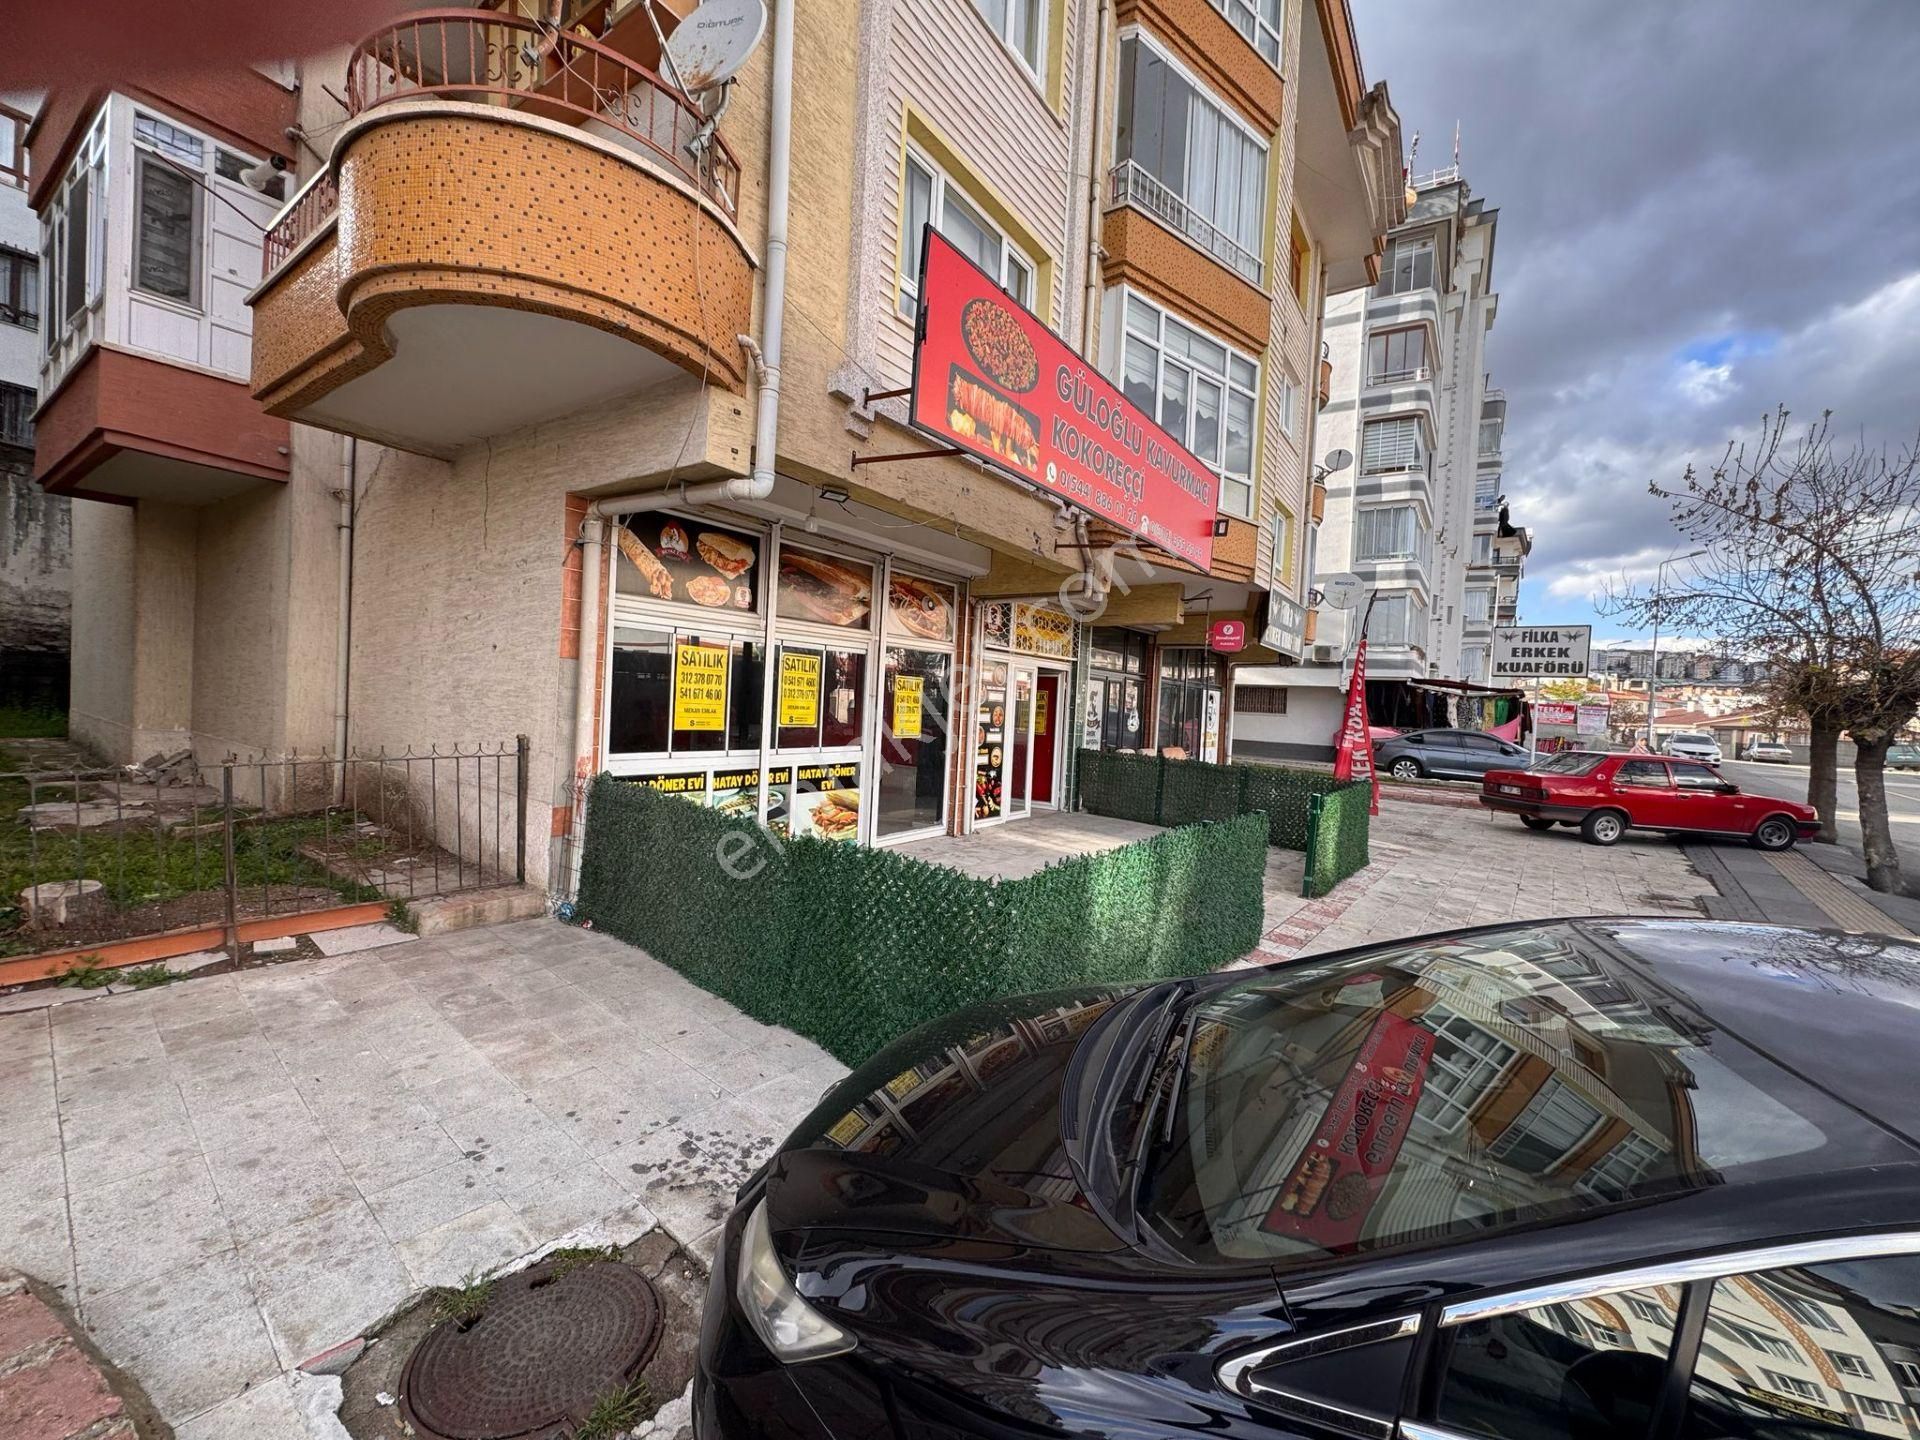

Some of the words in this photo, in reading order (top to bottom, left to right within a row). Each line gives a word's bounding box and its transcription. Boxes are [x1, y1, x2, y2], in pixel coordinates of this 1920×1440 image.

[1055, 364, 1143, 456] GÜLOĞLU
[1146, 436, 1211, 507] KAVURMACI
[1051, 413, 1145, 506] KOKOREÇÇİ
[1521, 629, 1559, 643] FİLKA
[681, 650, 724, 669] SATILIK
[1511, 647, 1570, 658] ERKEK
[784, 657, 818, 673] SATILIK
[1496, 660, 1584, 673] KUAFÖRÜ
[681, 671, 693, 684] 312
[680, 687, 692, 699] 541
[713, 775, 743, 789] HATAY
[745, 770, 774, 786] DÖR
[775, 768, 789, 783] EVİ
[799, 768, 826, 779] HATAY
[828, 765, 856, 777] DÖNER
[648, 775, 686, 791] DÖNER
[687, 773, 705, 790] EVİ
[821, 777, 836, 790] EVİ
